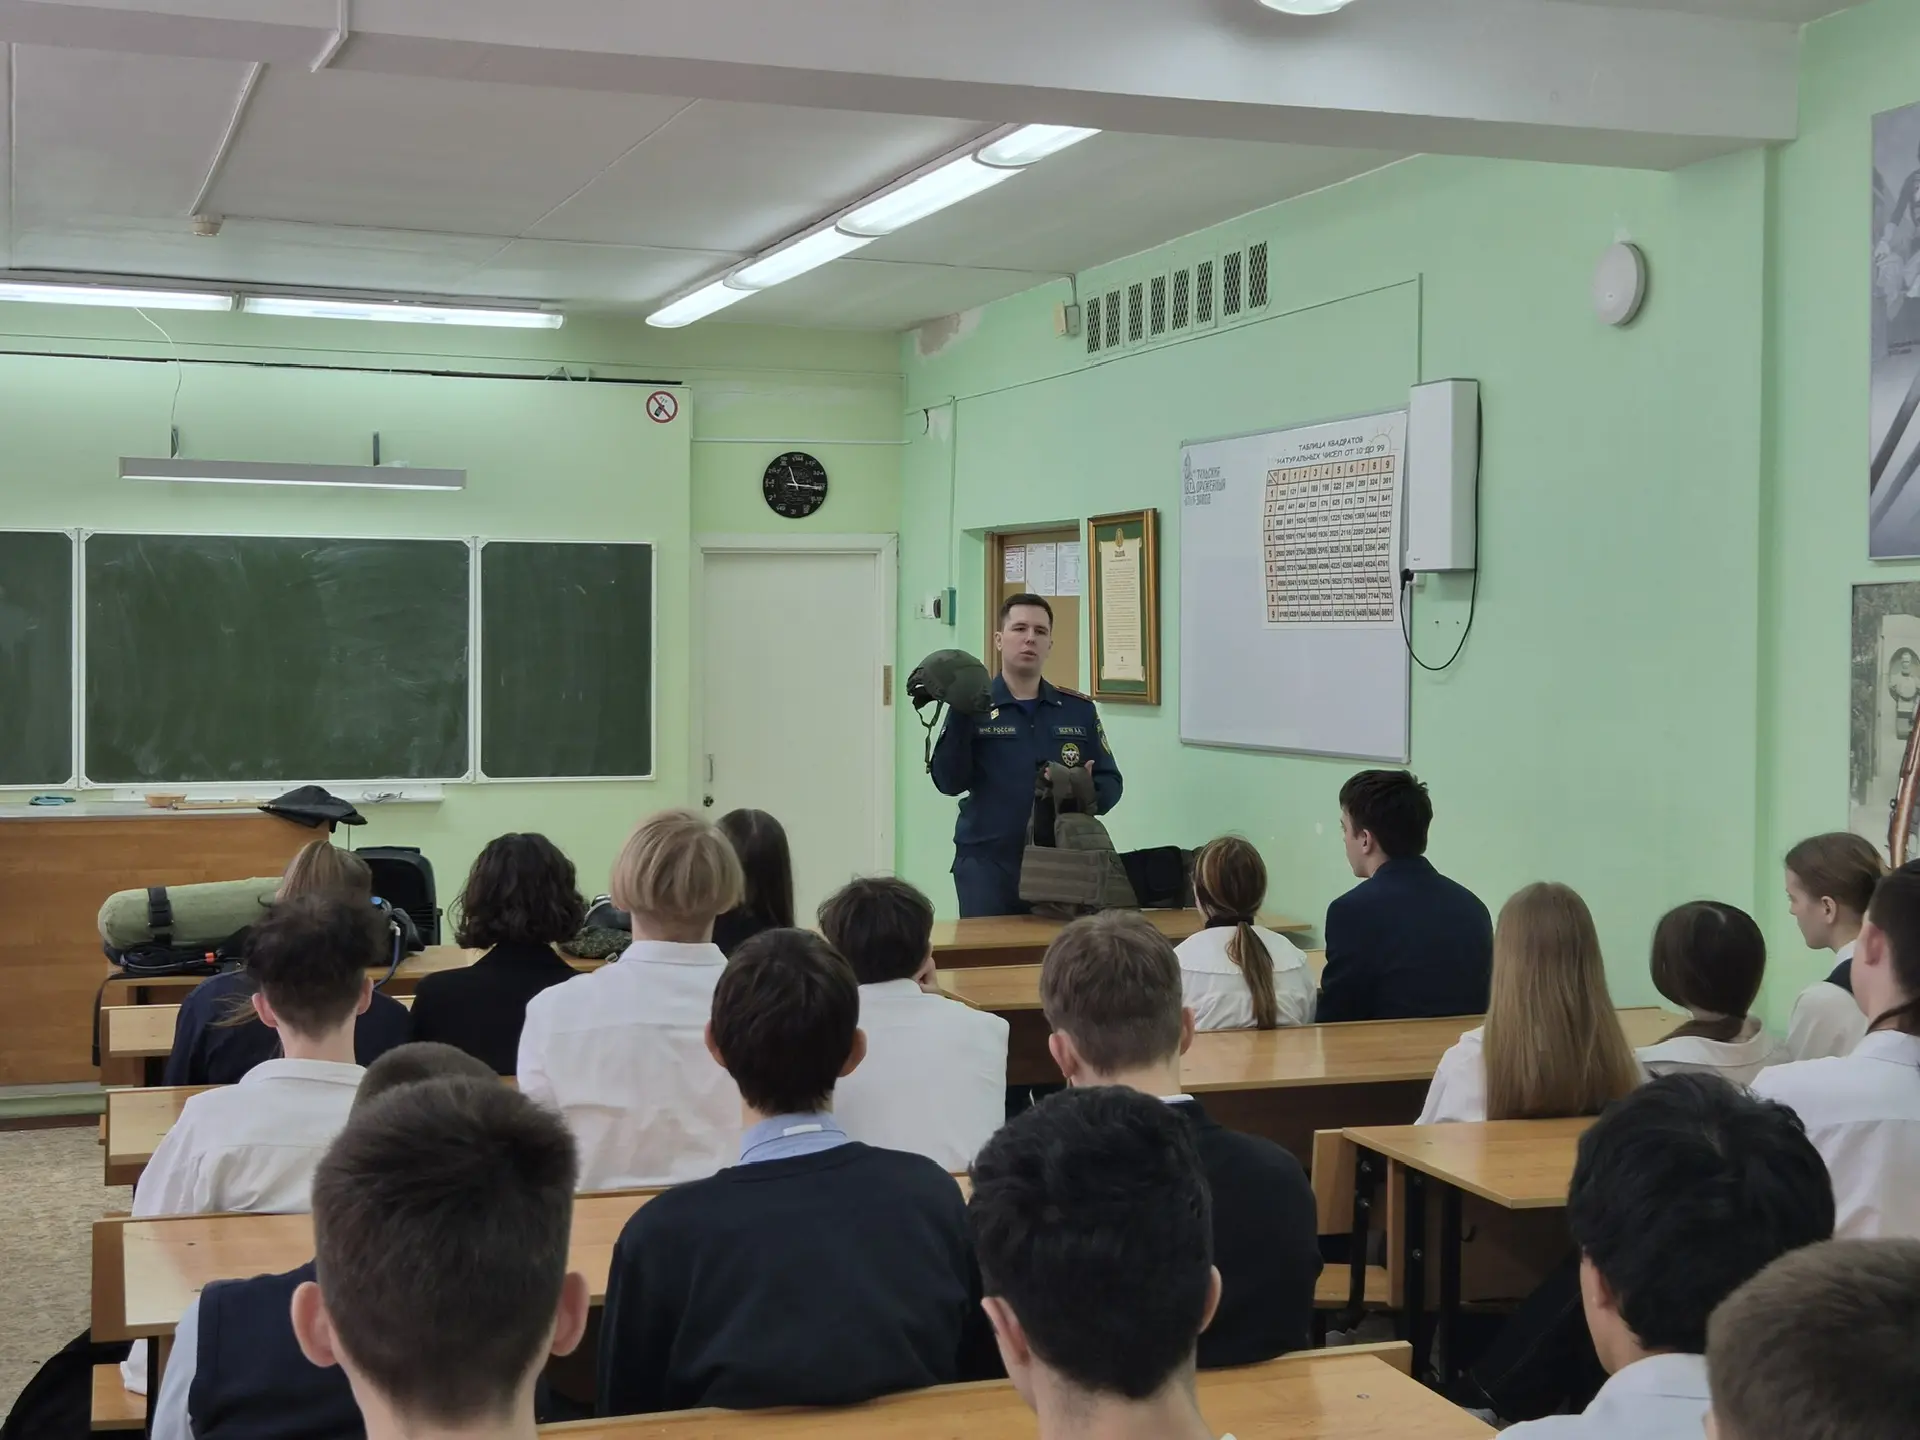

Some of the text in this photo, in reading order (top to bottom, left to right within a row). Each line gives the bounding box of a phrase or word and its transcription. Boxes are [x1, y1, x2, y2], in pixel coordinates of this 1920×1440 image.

[1298, 436, 1363, 451] ТАБЛИЦА КВАДРАТОВ
[1364, 446, 1374, 454] ДО
